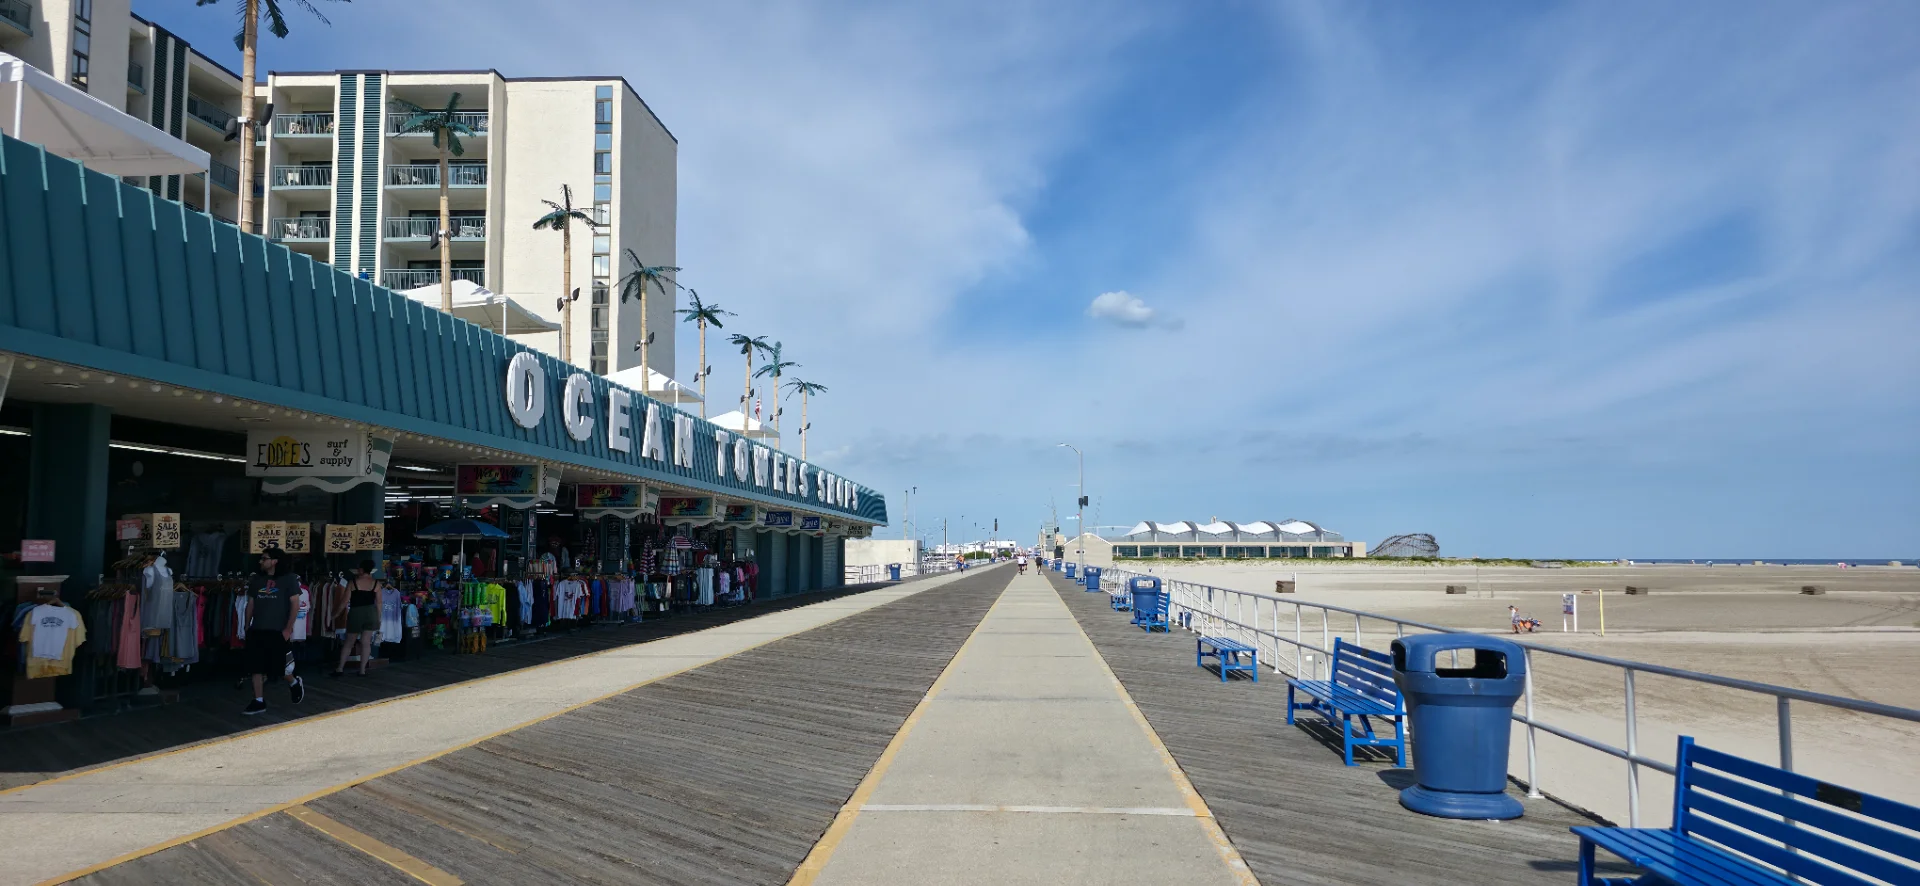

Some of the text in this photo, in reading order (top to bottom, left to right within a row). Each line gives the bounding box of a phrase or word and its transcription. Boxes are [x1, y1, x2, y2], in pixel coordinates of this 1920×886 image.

[507, 351, 859, 511] OCEAN TOWERS SHOPS
[326, 439, 349, 448] surf
[333, 448, 342, 456] &
[320, 455, 354, 467] supply
[157, 522, 178, 531] SALE
[156, 531, 162, 540] 2
[258, 529, 281, 537] SALE
[360, 530, 381, 538] SALE
[258, 539, 280, 550] $5
[331, 540, 351, 550] $5
